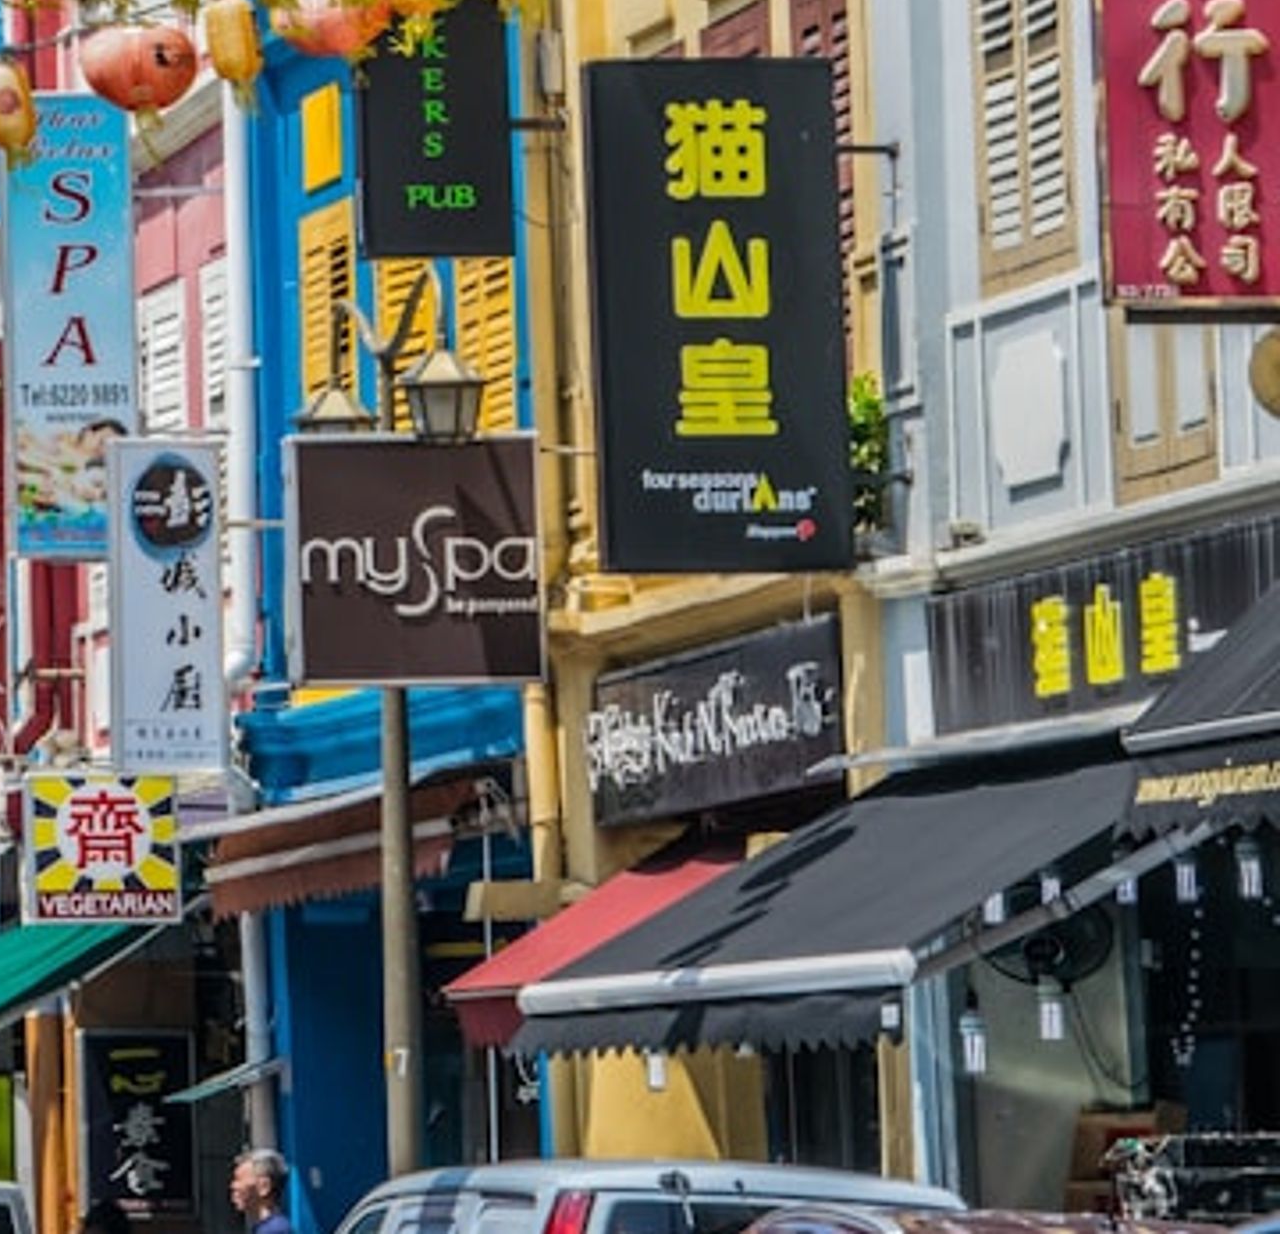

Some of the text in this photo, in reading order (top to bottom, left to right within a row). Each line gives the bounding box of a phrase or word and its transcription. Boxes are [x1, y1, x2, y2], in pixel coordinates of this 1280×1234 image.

[405, 183, 477, 209] PUB
[44, 171, 98, 365] SPA
[664, 98, 778, 437] 猫山皇
[42, 890, 173, 917] VEGETARIAN
